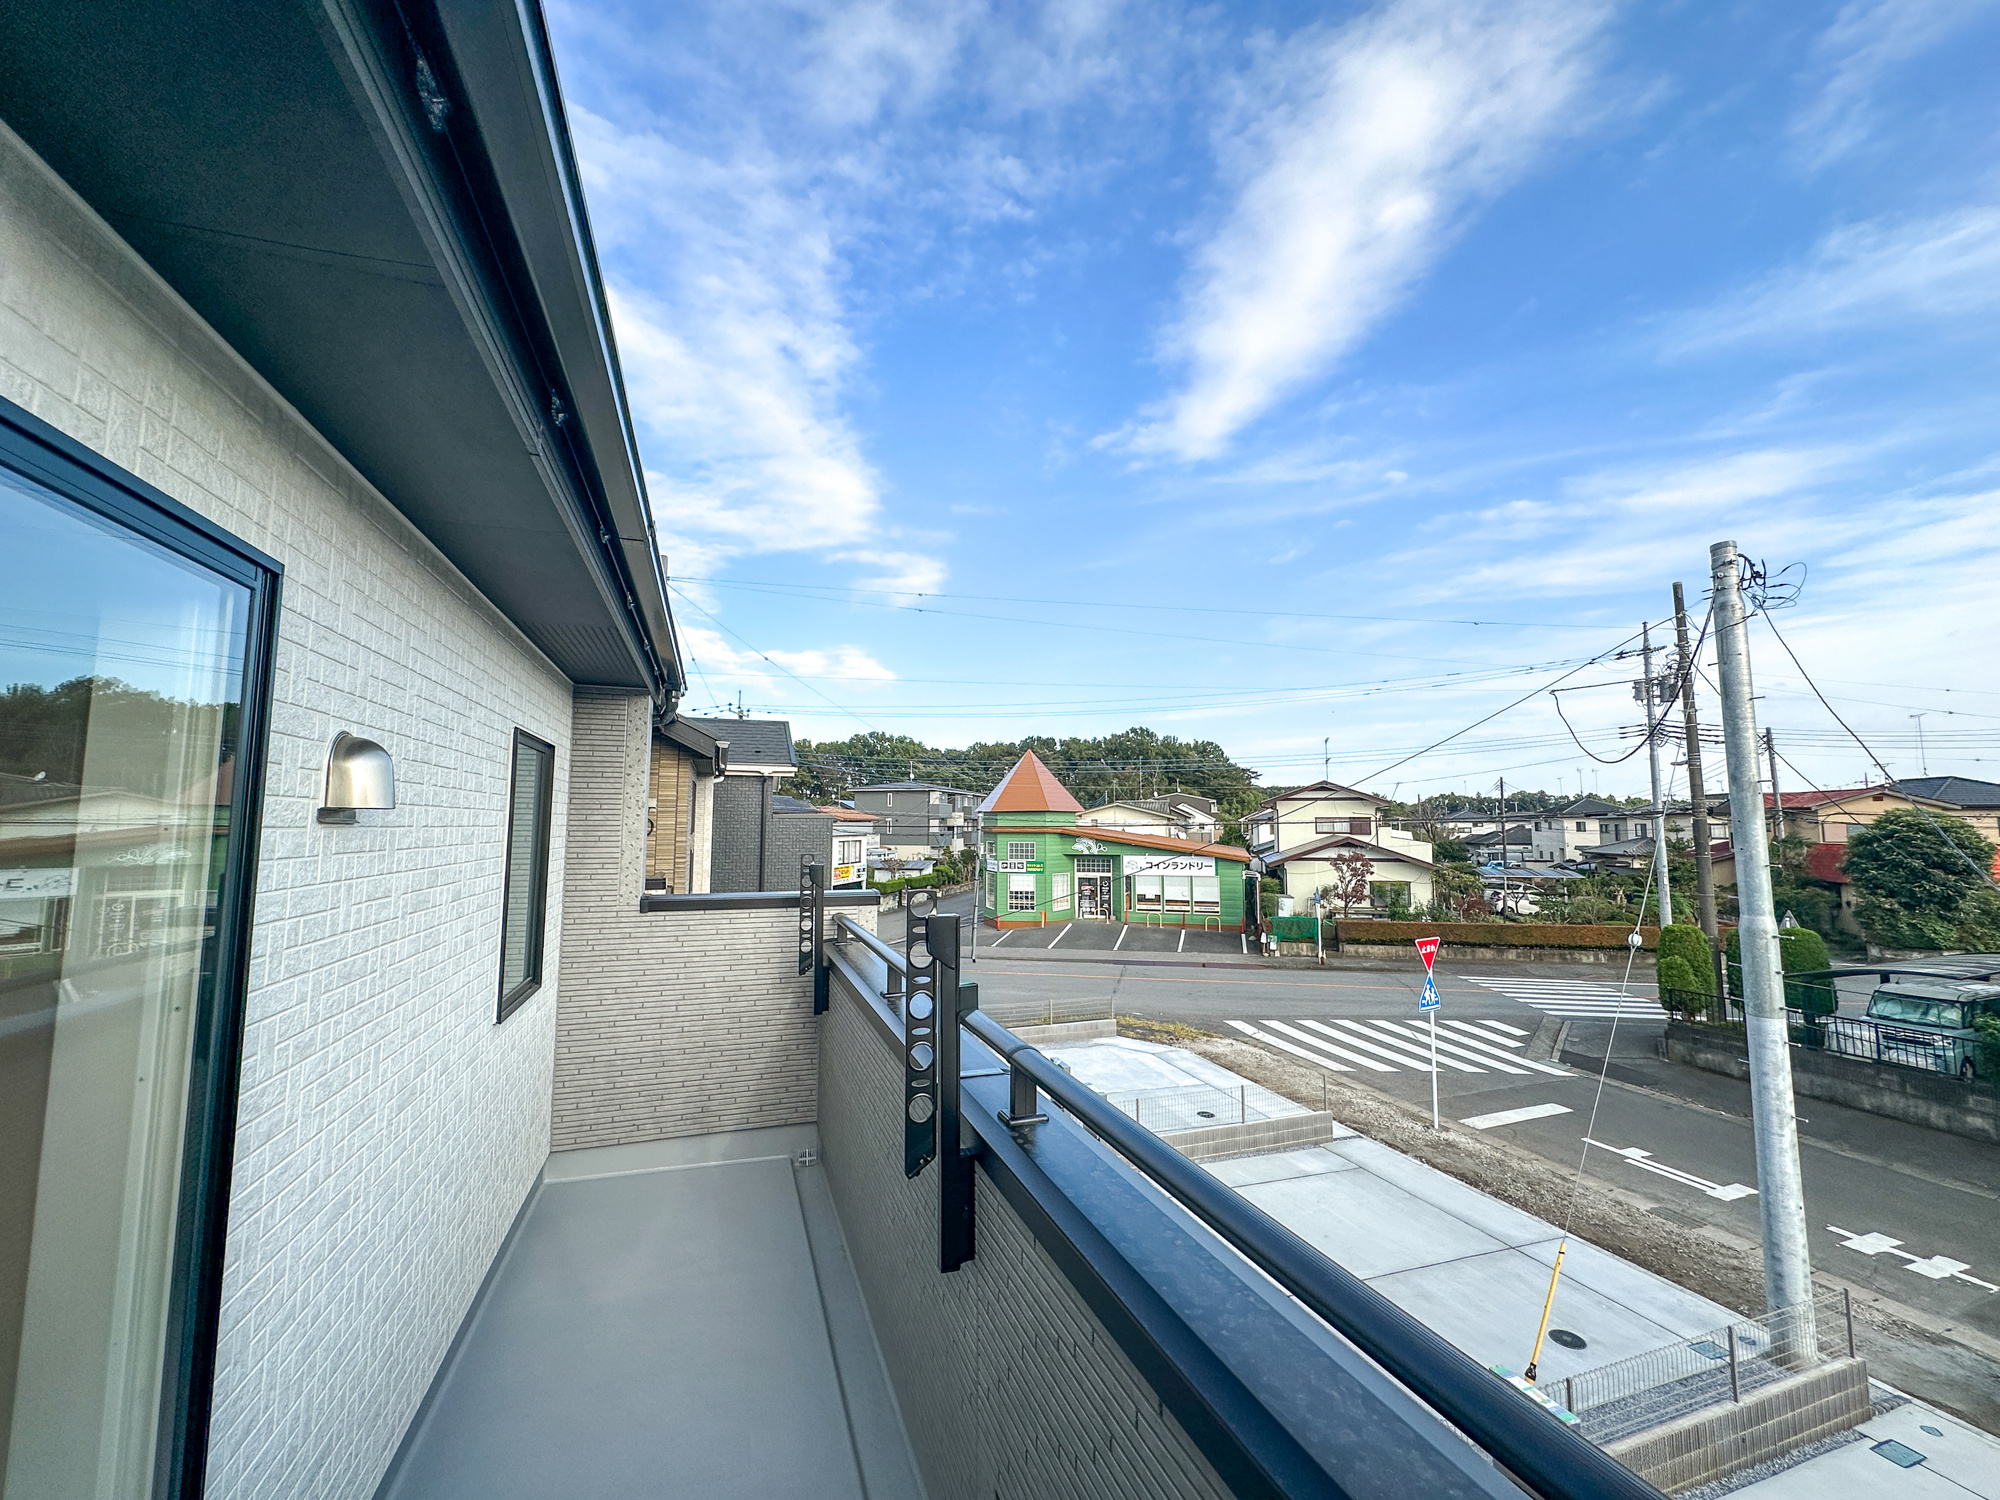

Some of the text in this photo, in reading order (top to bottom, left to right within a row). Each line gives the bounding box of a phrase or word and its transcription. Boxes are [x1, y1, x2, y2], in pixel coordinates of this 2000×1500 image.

[1146, 861, 1213, 870] コインランドリー
[1421, 944, 1436, 953] 止まれ
